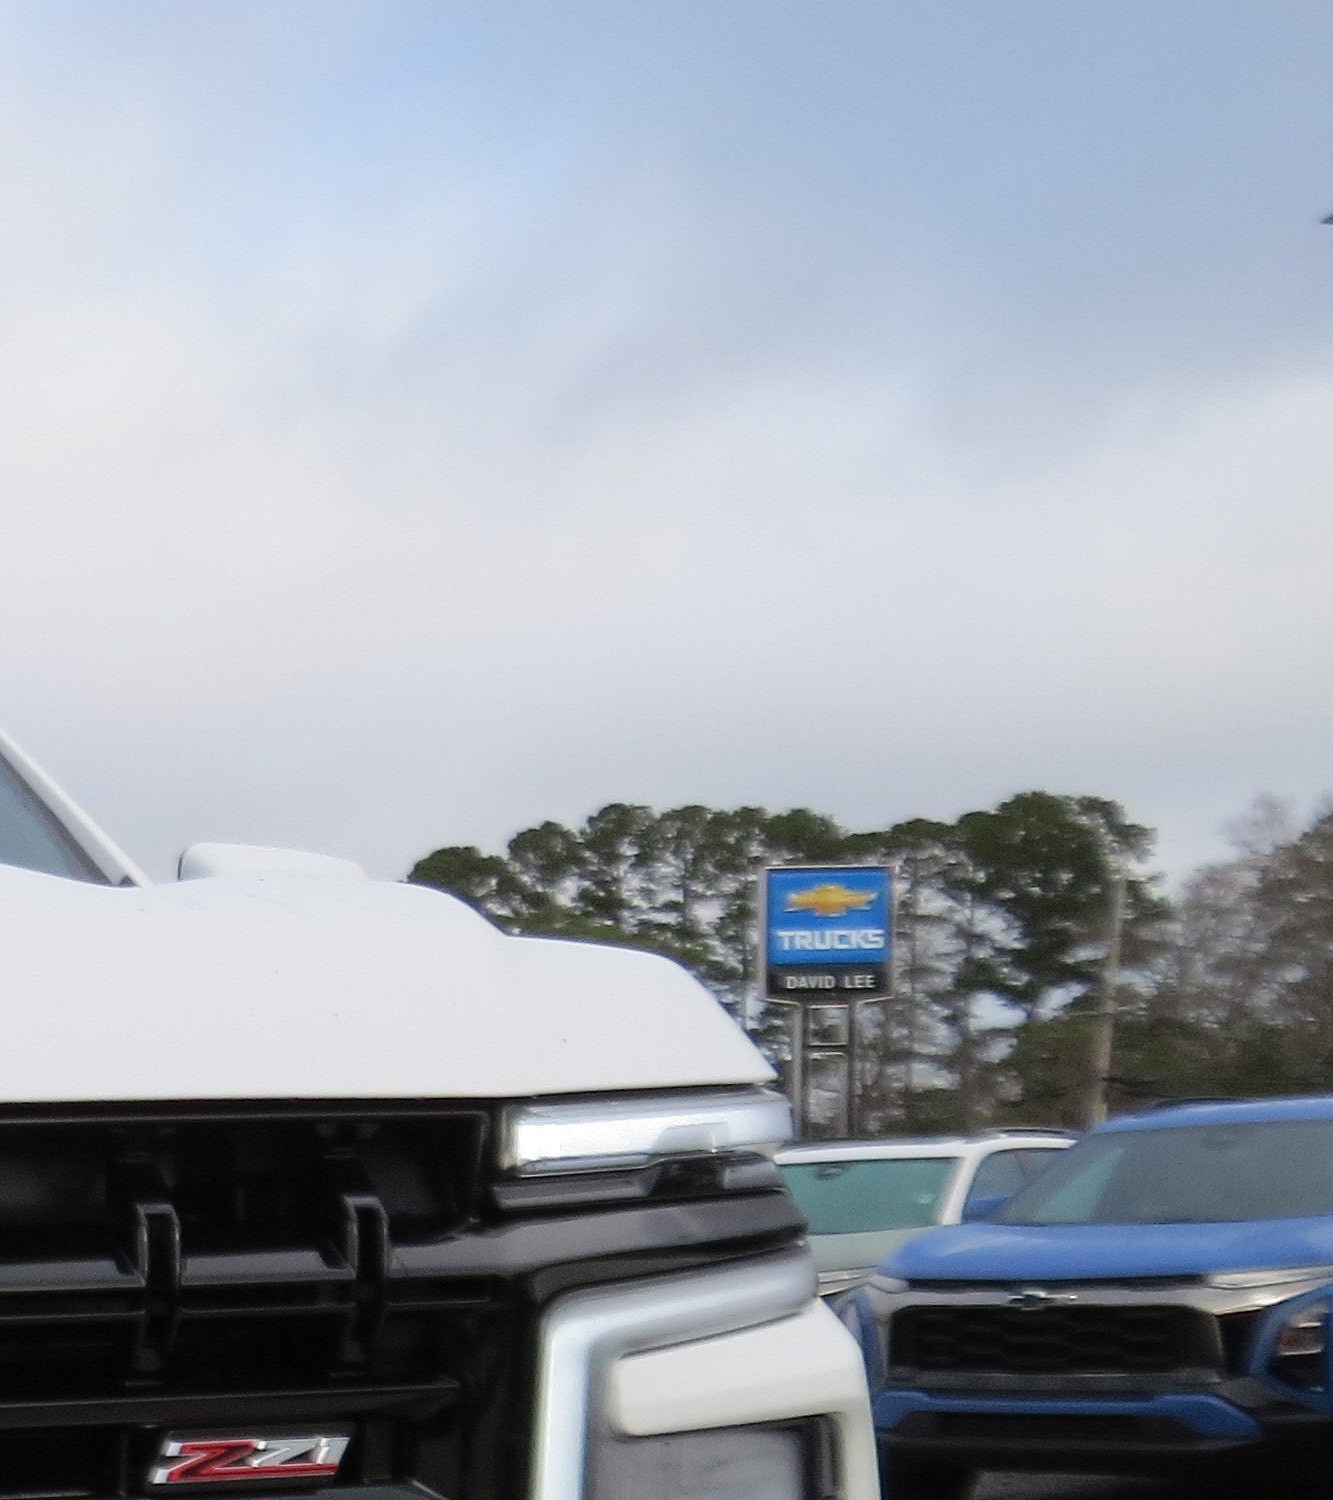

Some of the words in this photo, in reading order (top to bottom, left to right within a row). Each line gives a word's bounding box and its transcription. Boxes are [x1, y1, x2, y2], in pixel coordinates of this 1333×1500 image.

[777, 929, 885, 949] TRUCKS
[786, 975, 835, 989] DAVID
[844, 975, 875, 989] LEE
